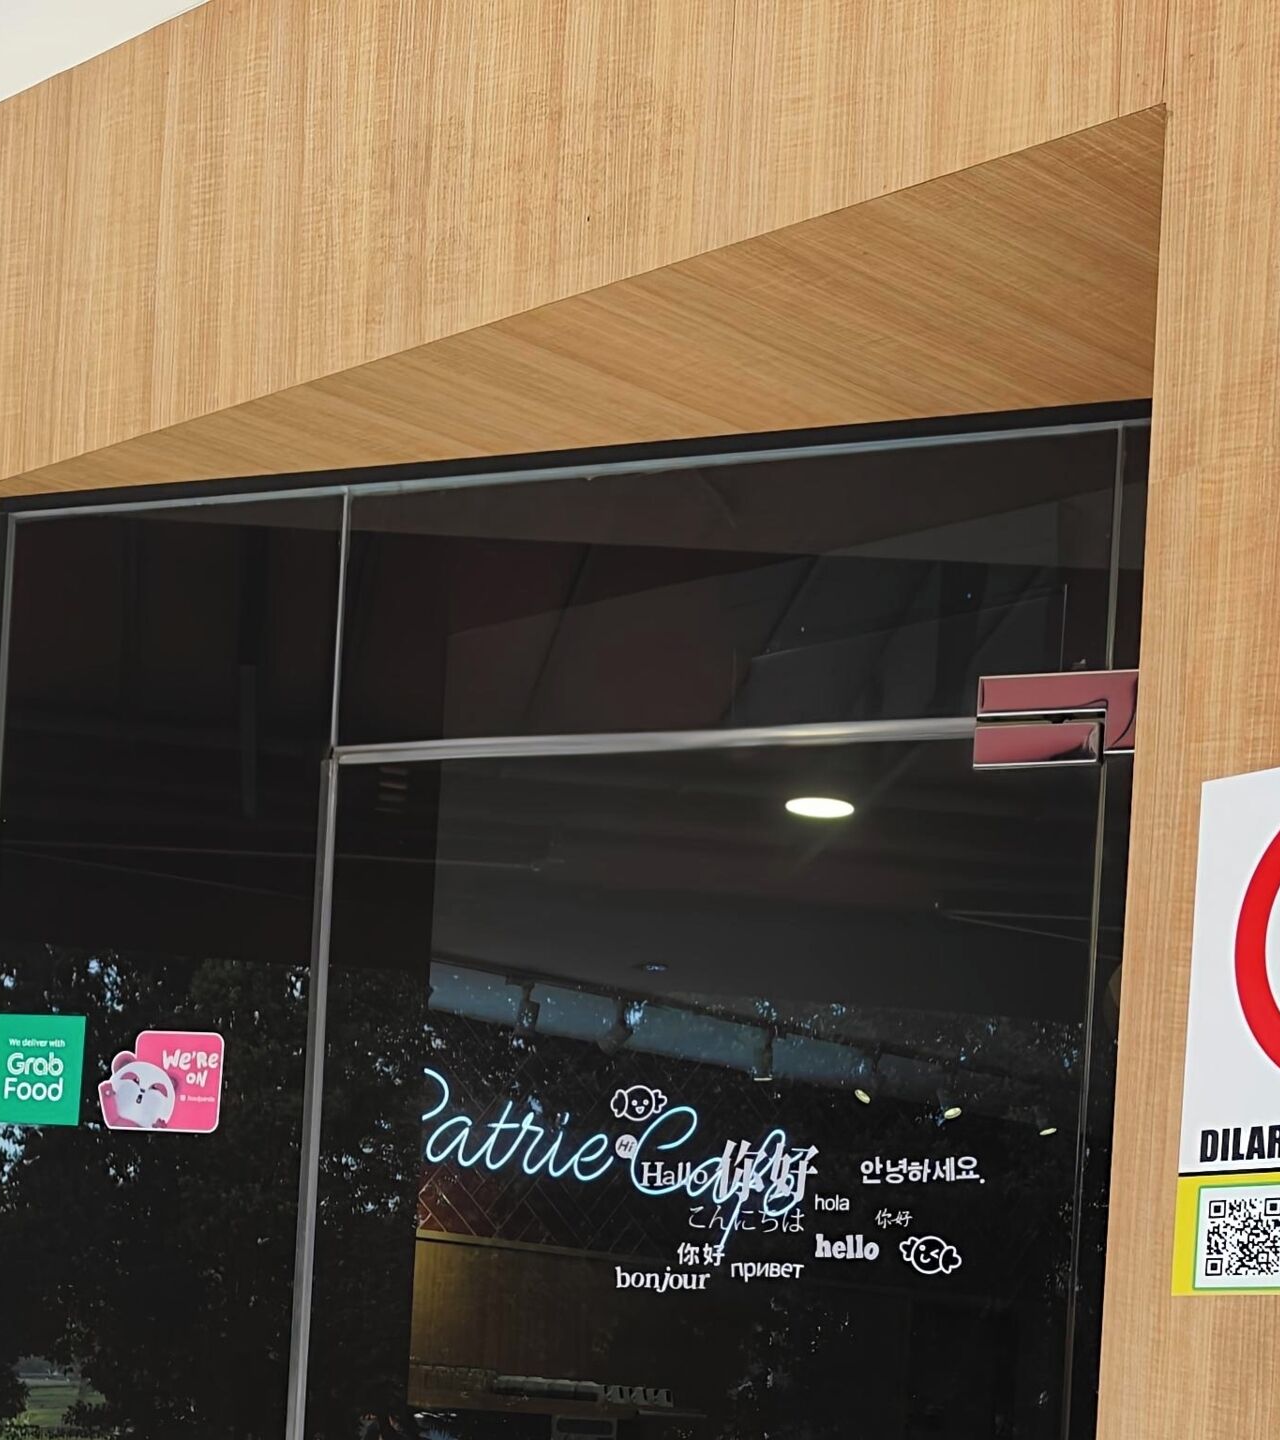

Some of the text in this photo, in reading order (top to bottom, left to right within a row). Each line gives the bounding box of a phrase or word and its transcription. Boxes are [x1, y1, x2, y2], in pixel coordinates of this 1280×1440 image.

[8, 1038, 66, 1047] We deliver with
[7, 1052, 64, 1077] Grab
[4, 1077, 64, 1101] Food
[640, 1162, 708, 1186] Hallo
[717, 1140, 820, 1202] 你好
[815, 1194, 850, 1211] hola
[689, 1205, 805, 1233] こんにちは
[875, 1208, 913, 1229] 你好
[677, 1242, 725, 1267] 你好
[815, 1233, 880, 1261] hello
[615, 1266, 710, 1293] bonjour
[731, 1262, 805, 1283] привет
